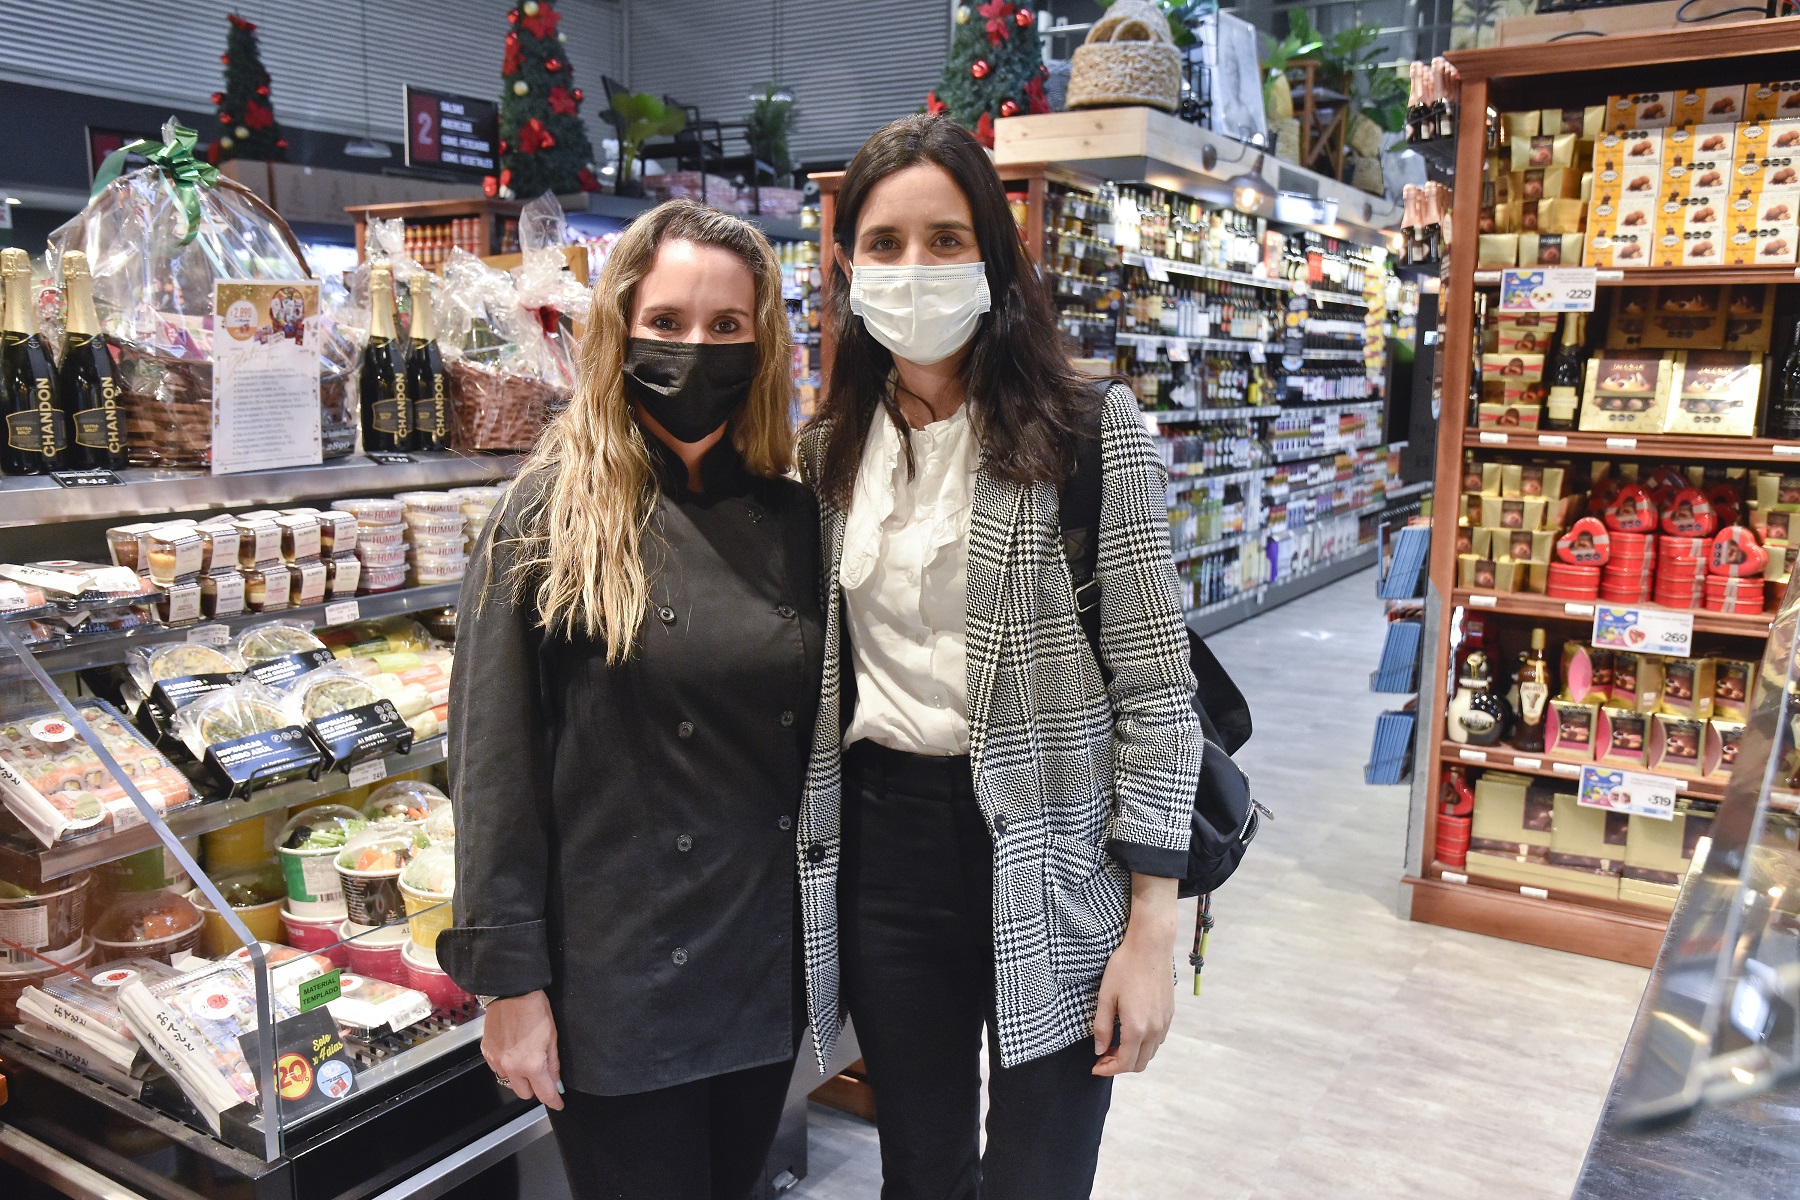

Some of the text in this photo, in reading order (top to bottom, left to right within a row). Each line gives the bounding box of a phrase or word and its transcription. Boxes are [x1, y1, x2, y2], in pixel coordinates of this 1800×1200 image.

[418, 111, 433, 145] 2
[101, 376, 120, 453] CHANDON
[395, 372, 407, 438] CHANDON
[434, 373, 445, 437] CHANDON
[36, 377, 56, 457] CHANDON
[253, 660, 294, 676] ESPINACAS
[315, 713, 355, 731] ESPINACAS
[215, 740, 263, 757] ESPINACAS
[220, 750, 251, 764] QUESO
[302, 985, 339, 1006] TEMPLADO
[303, 977, 337, 996] MATERIAL
[312, 1033, 332, 1052] Solo
[319, 1045, 327, 1061] 4
